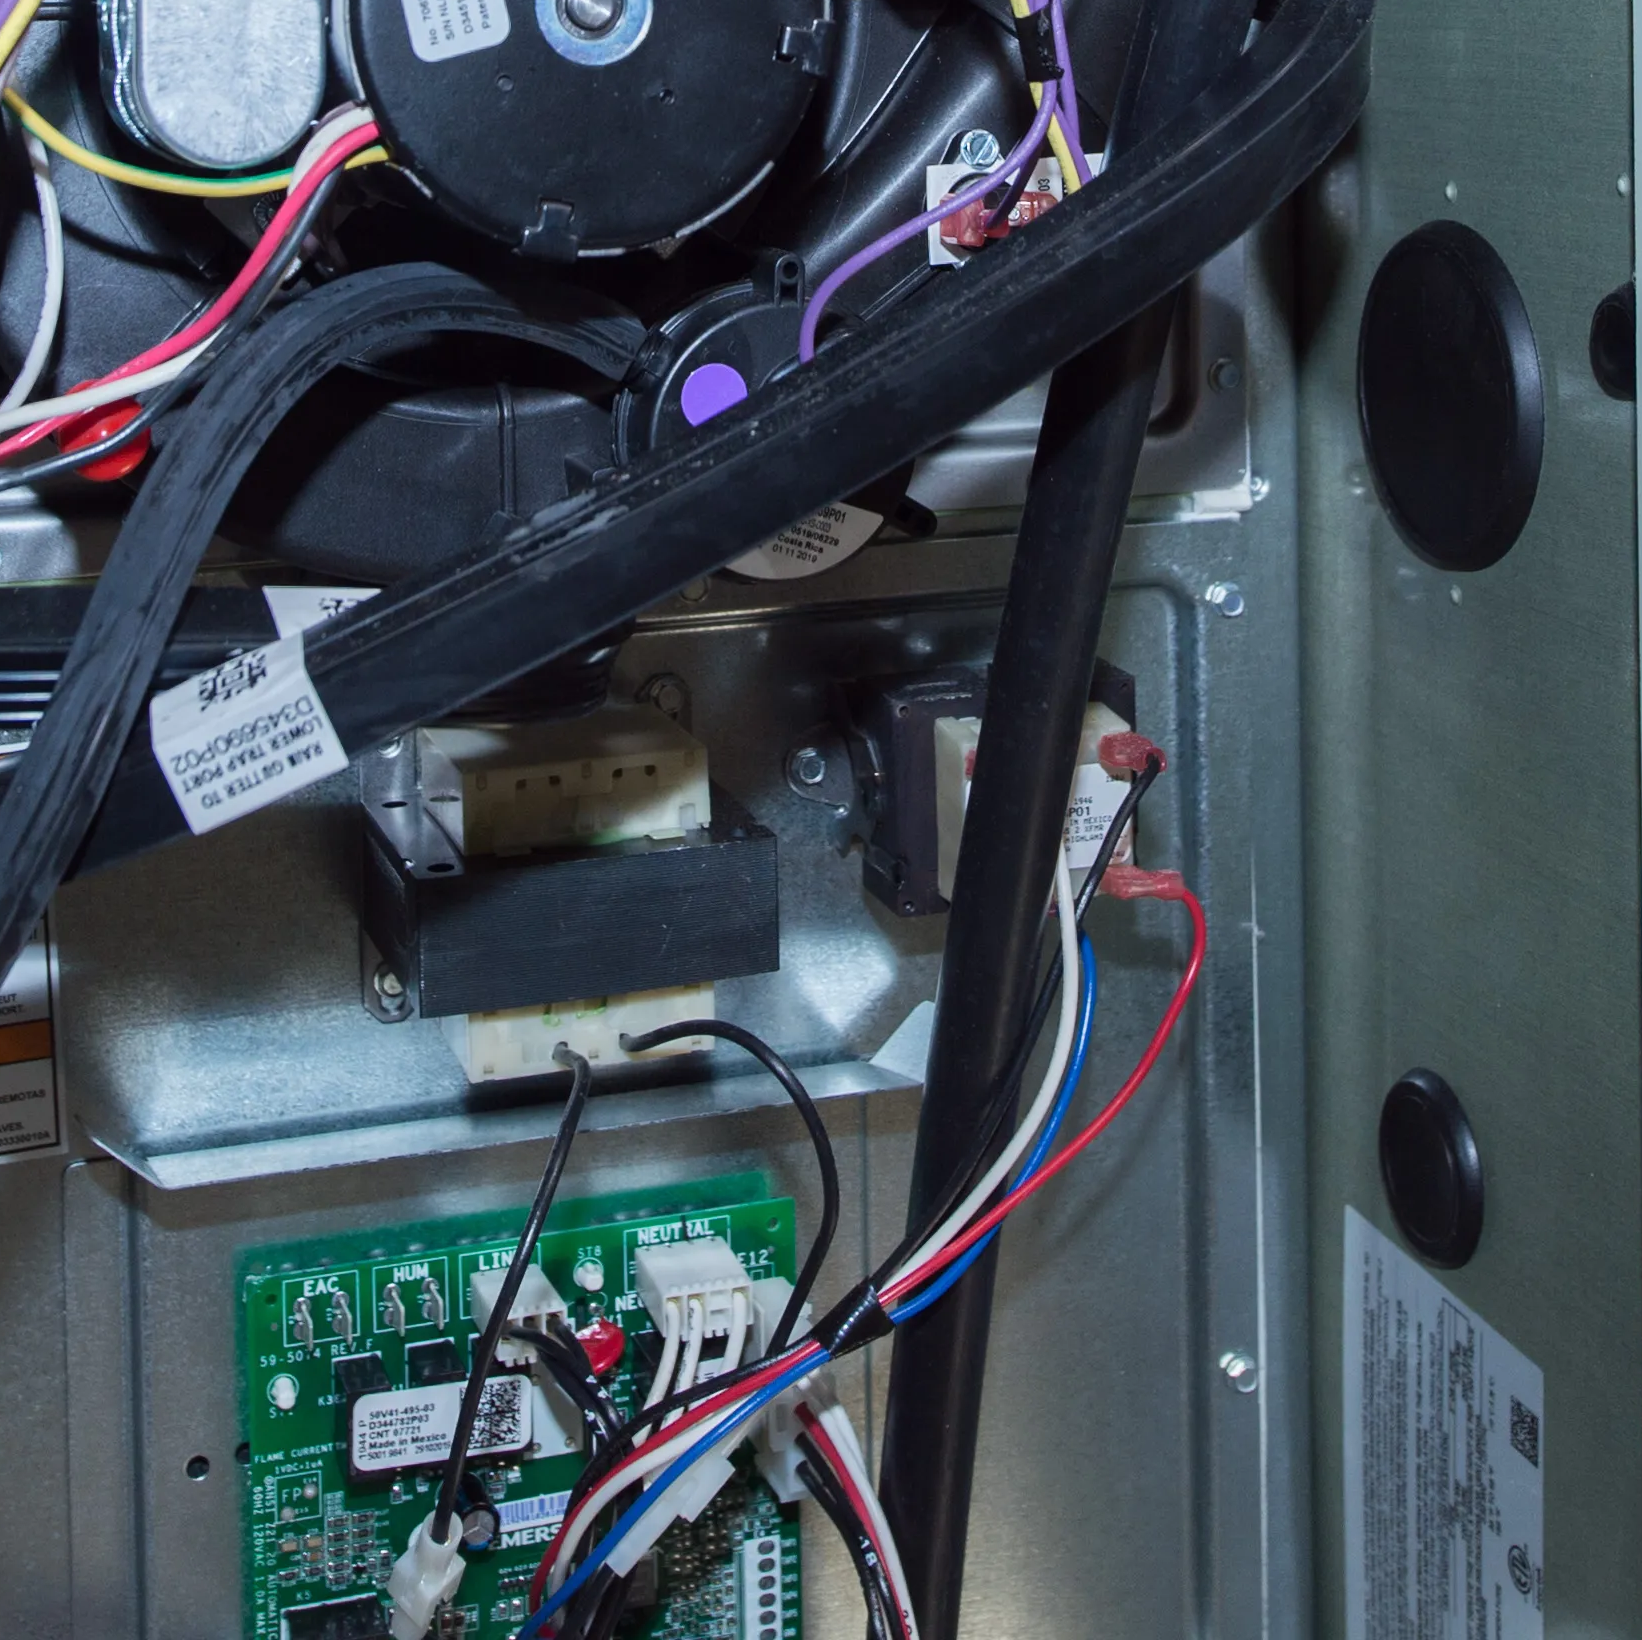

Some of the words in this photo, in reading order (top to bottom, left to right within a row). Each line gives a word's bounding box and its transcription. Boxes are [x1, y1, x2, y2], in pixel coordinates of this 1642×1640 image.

[268, 714, 324, 751] LOWER
[227, 744, 266, 773] TRAP
[181, 763, 224, 795] PORT
[200, 791, 223, 810] TO
[637, 1219, 715, 1245] NEUTRAL
[393, 1262, 429, 1283] HUM
[303, 1276, 341, 1297] EAC
[368, 1428, 389, 1440] CNT
[368, 1438, 396, 1450] Made
[398, 1437, 408, 1446] in
[410, 1432, 447, 1444] Mexico
[254, 1451, 285, 1464] FLAME
[291, 1442, 334, 1458] CURRENT
[281, 1487, 302, 1504] FP
